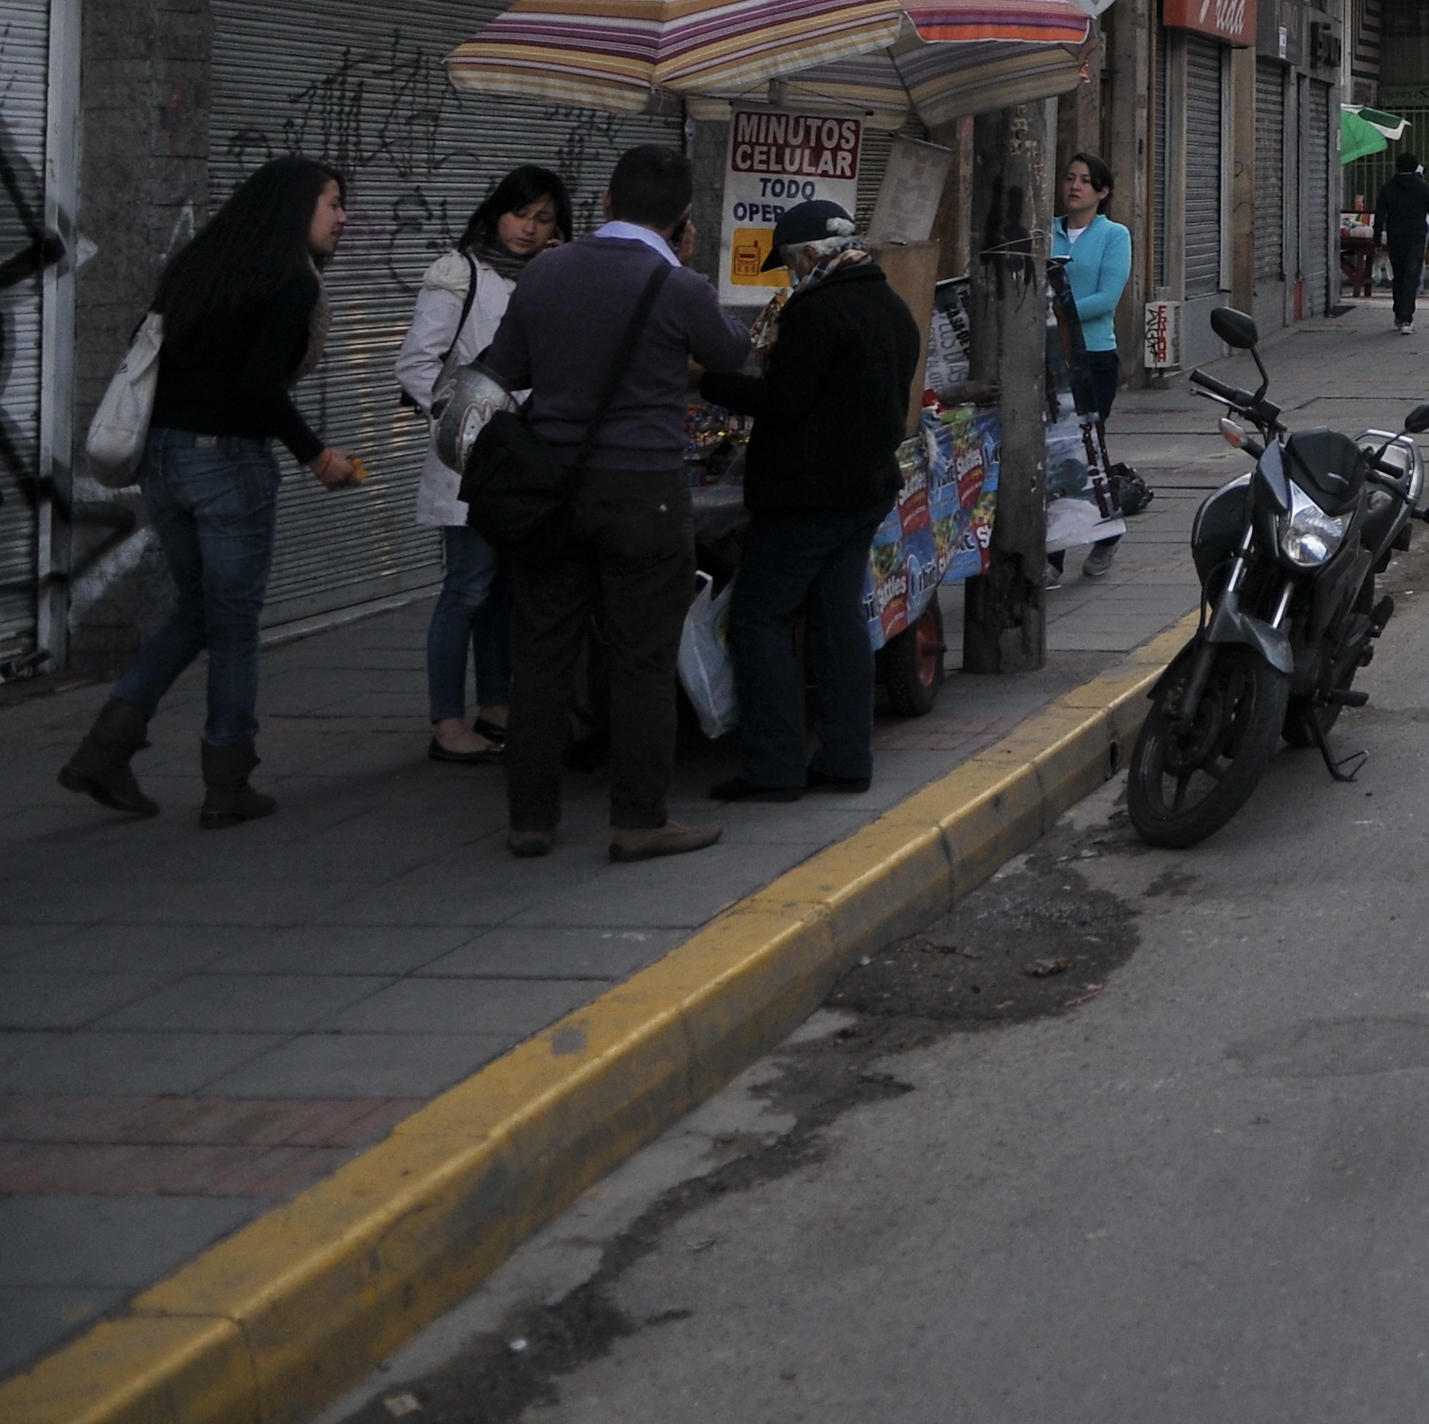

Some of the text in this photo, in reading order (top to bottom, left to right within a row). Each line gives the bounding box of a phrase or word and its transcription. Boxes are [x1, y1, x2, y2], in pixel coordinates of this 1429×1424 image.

[737, 113, 857, 150] MINUTOS
[735, 144, 852, 176] CELULAR
[760, 178, 816, 200] TODO
